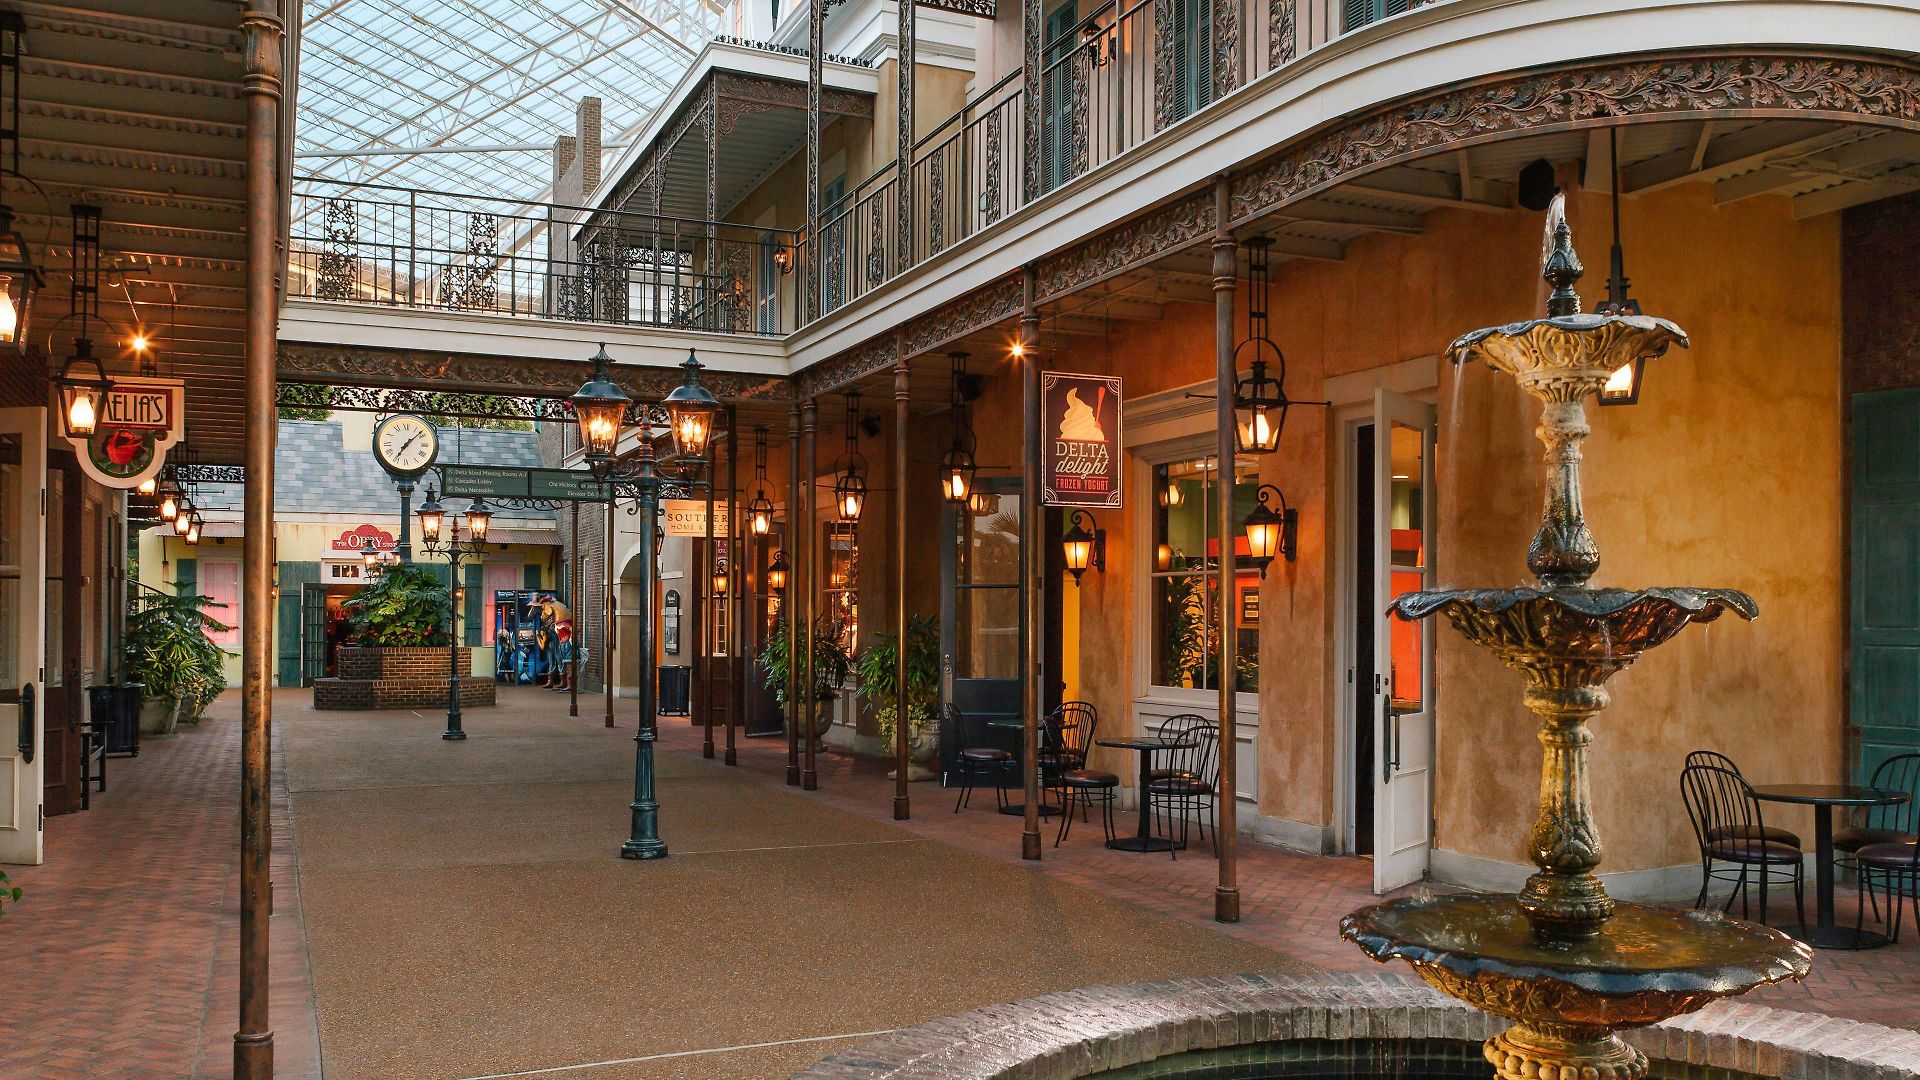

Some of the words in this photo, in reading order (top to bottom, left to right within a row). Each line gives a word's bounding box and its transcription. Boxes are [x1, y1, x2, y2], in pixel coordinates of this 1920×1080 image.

[1055, 441, 1109, 458] DELTA
[1055, 457, 1109, 479] delight
[1055, 479, 1081, 489] FROZEN
[1084, 480, 1109, 490] YOGURT
